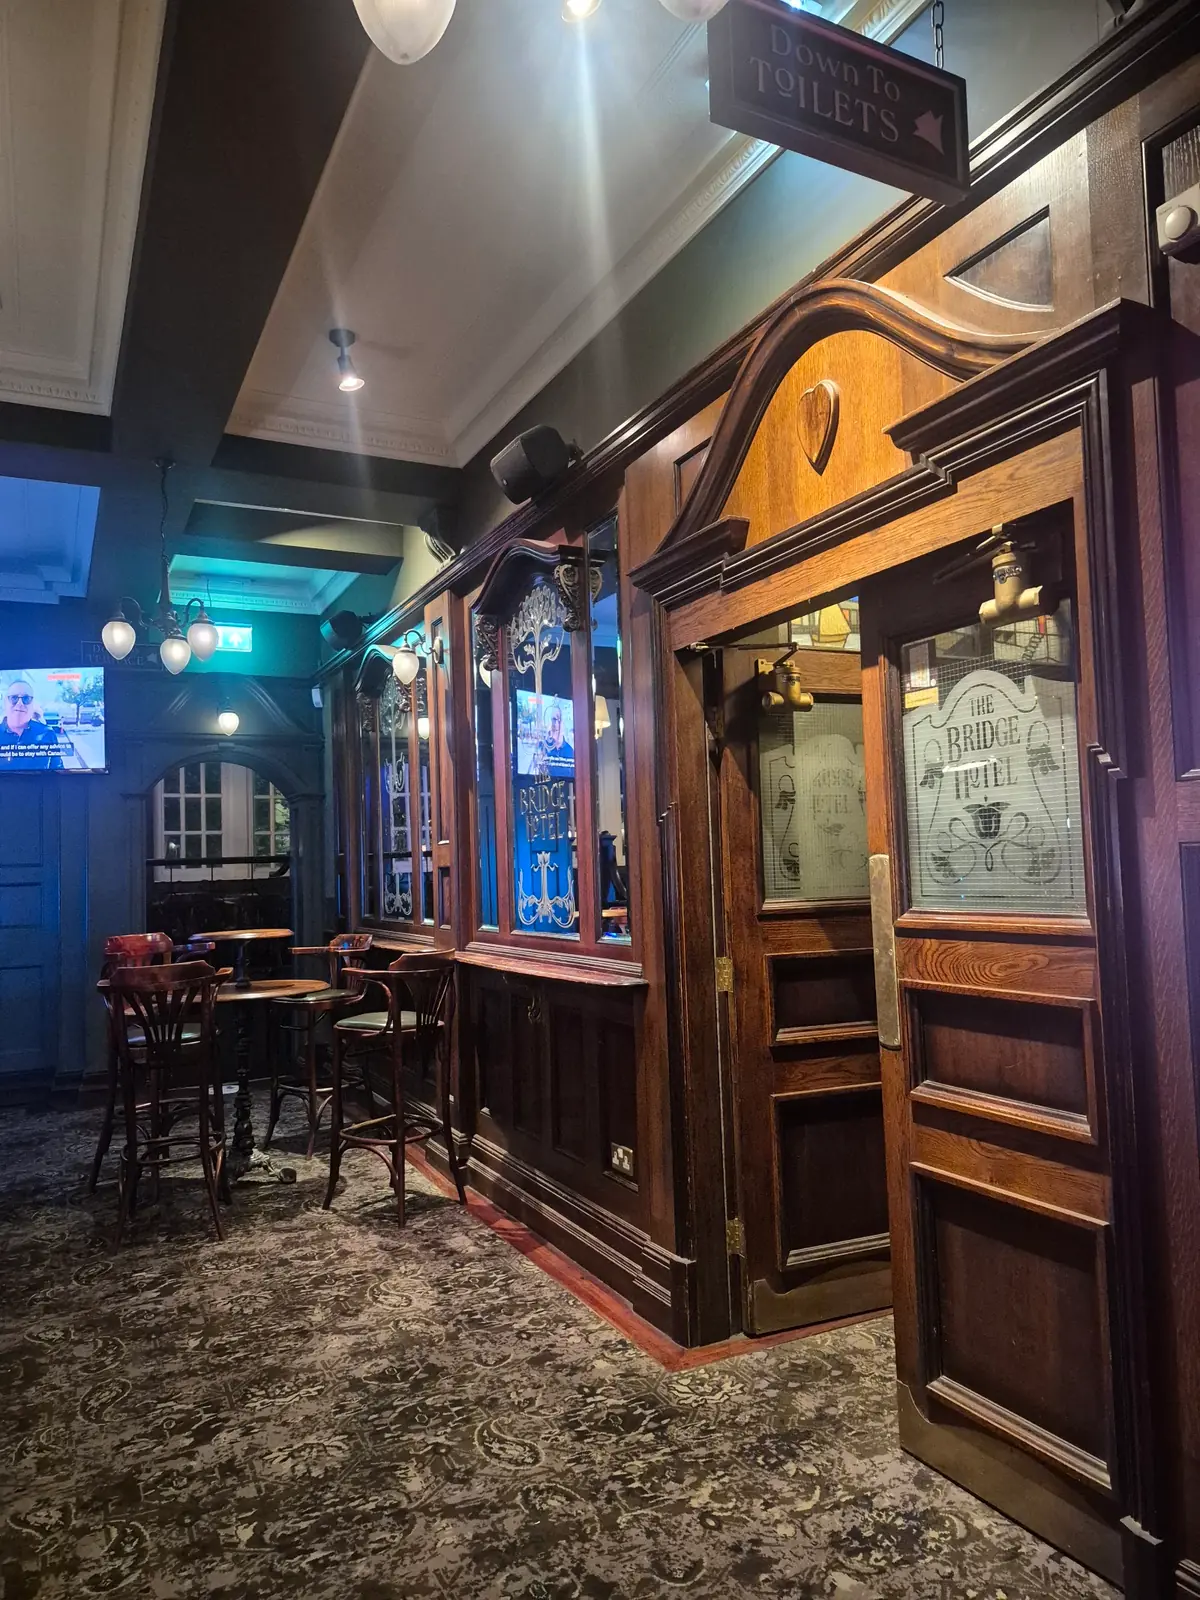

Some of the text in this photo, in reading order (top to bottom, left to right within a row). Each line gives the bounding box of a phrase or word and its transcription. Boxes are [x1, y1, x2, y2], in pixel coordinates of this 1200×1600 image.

[770, 24, 901, 102] Down To
[751, 56, 900, 142] TOILETS
[970, 694, 995, 717] THE
[946, 715, 1021, 764] BRIDGE
[519, 781, 567, 815] BRIDGE
[955, 756, 1018, 801] HOTEL
